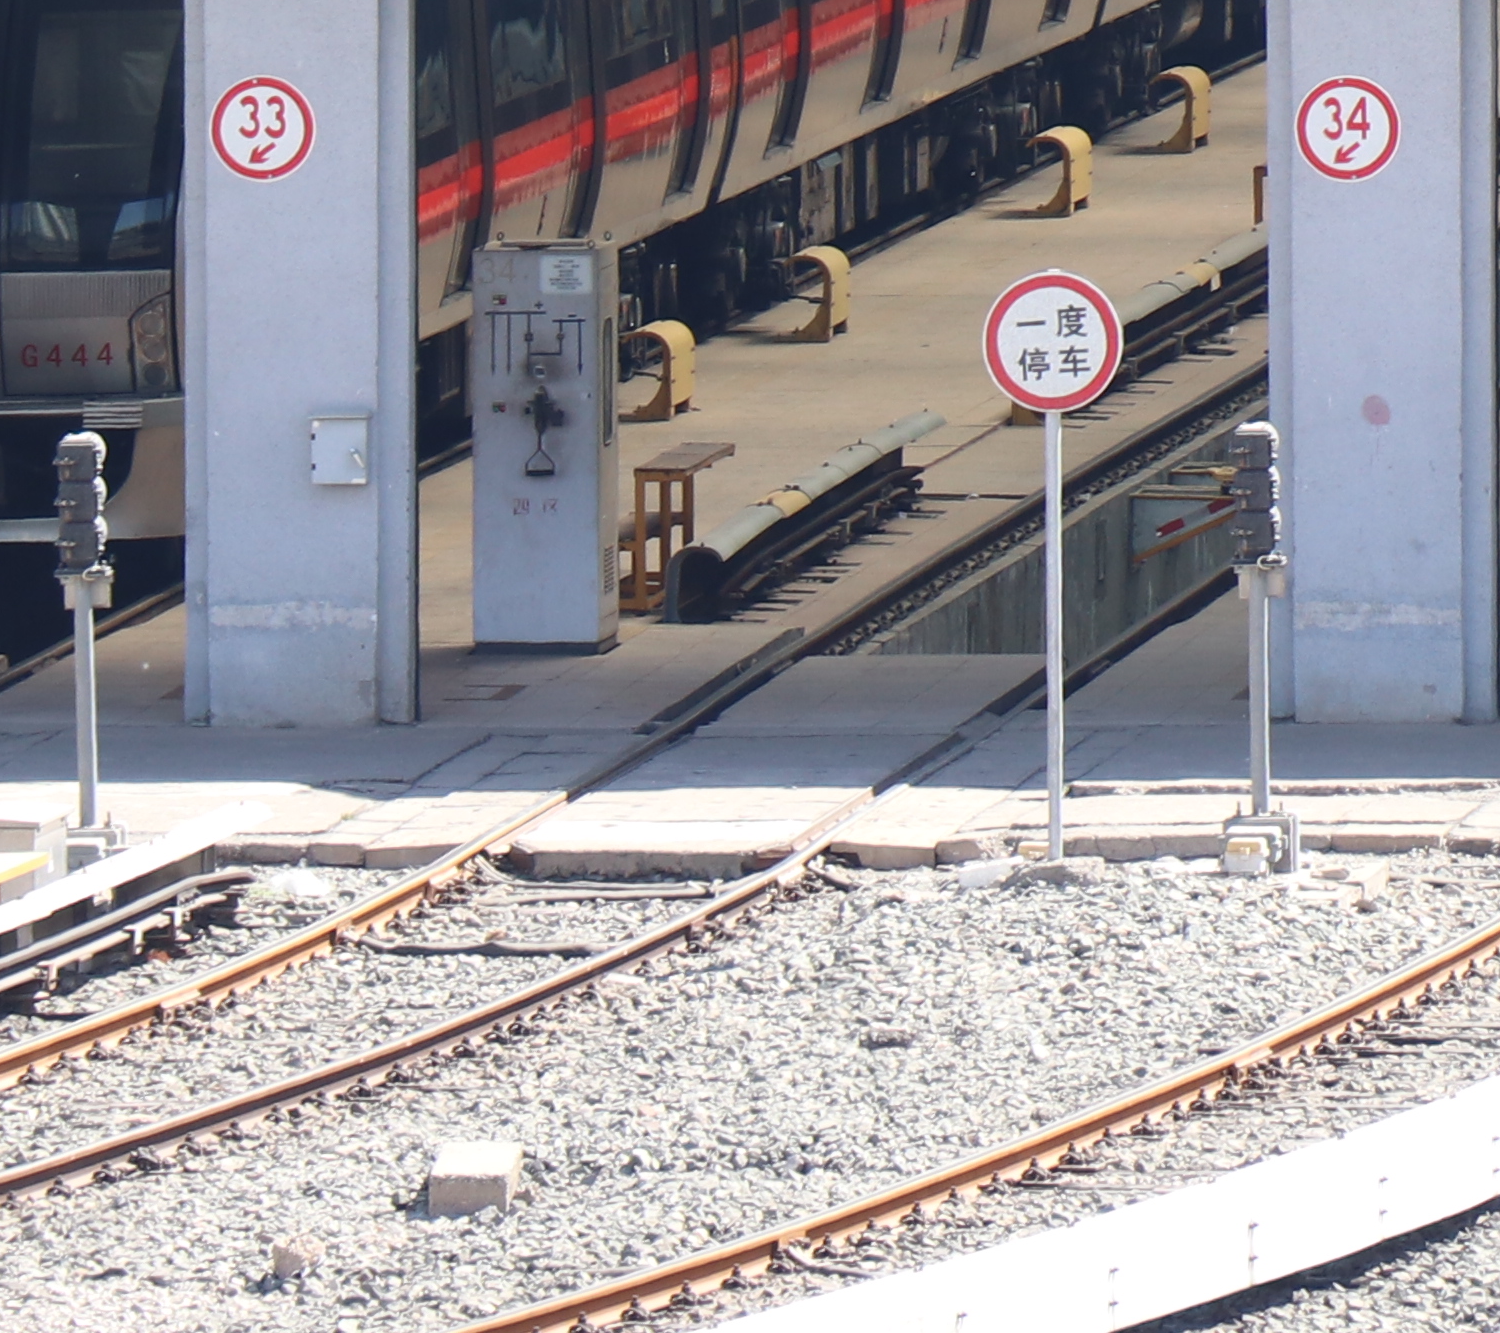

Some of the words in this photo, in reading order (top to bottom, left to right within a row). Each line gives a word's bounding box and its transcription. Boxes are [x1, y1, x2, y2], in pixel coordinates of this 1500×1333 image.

[238, 95, 286, 139] 33
[1323, 96, 1370, 141] 34
[478, 258, 515, 284] 34
[1016, 304, 1088, 338] 一度
[20, 342, 113, 369] G444
[1018, 345, 1091, 381] 停车
